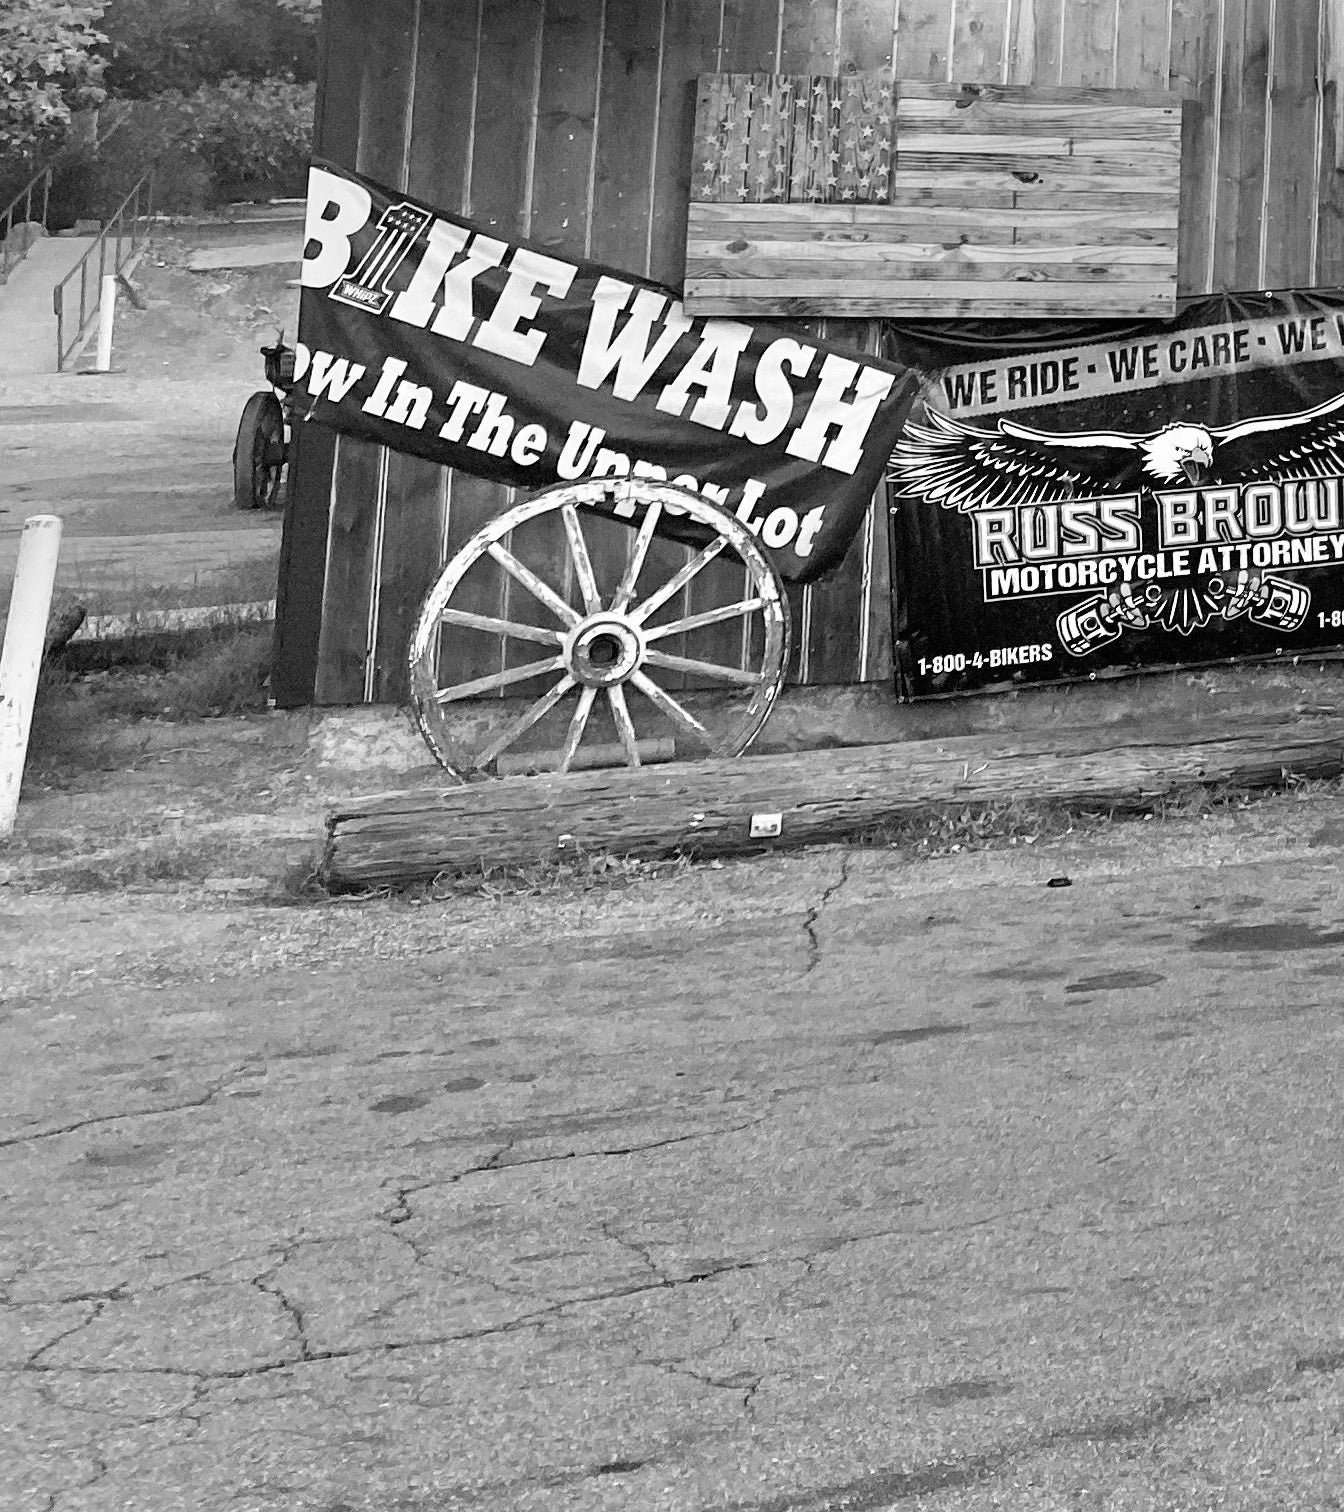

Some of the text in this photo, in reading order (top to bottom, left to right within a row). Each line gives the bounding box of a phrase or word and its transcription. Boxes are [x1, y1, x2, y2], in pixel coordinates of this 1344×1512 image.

[576, 275, 897, 475] WASH
[942, 368, 997, 410] WE
[1007, 357, 1082, 401] RIDE
[1107, 344, 1161, 384] WE
[1169, 329, 1251, 373] CARE
[1278, 316, 1327, 355] WE
[362, 356, 434, 430] In
[438, 380, 548, 466] The
[735, 478, 825, 558] Lot
[977, 496, 1141, 565] RUSS
[990, 549, 1190, 597] MOTORCYCLE
[918, 642, 1053, 676] 1-800-4-BIKERS
